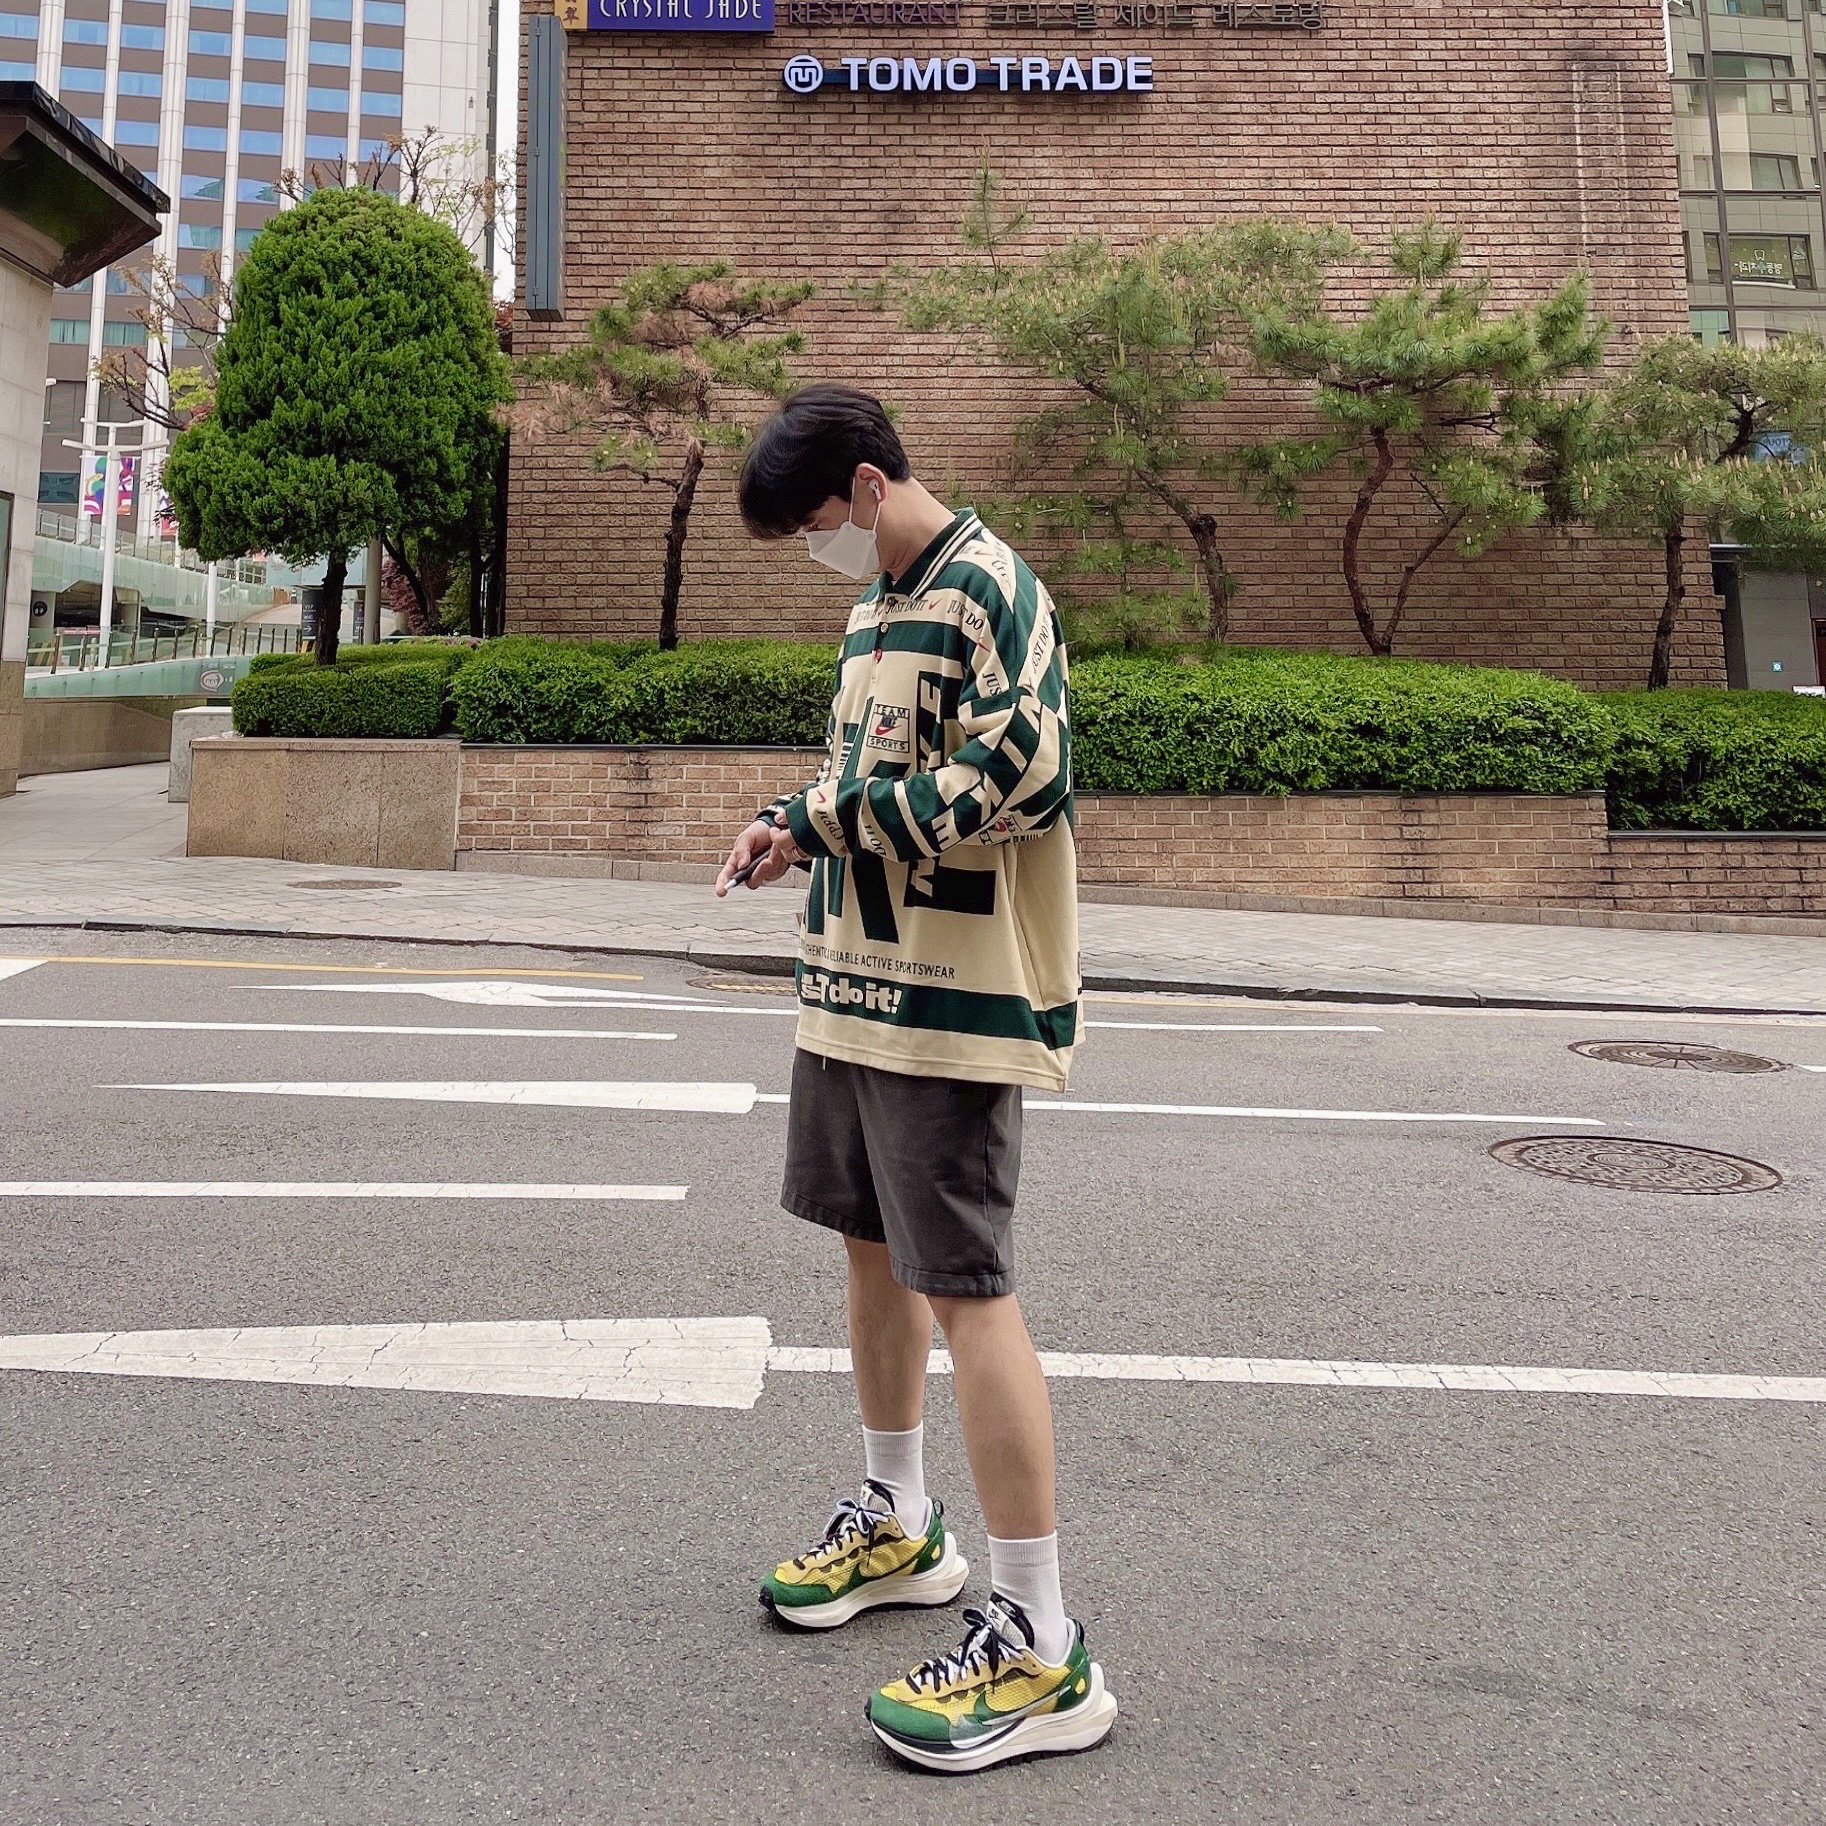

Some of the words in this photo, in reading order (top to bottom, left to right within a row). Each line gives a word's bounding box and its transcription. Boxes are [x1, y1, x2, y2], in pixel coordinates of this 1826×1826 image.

[600, 0, 692, 18] CRYSTAL
[705, 0, 762, 19] JADE
[788, 1, 960, 25] RESTAURANT
[1213, 1, 1325, 29] 레스토랑
[841, 57, 976, 91] TOMO
[990, 57, 1153, 91] TRADE
[947, 600, 968, 619] JUST
[965, 613, 984, 631] DO
[982, 672, 1001, 696] JUS
[876, 704, 908, 719] TEAM
[870, 737, 905, 751] SPORTS
[861, 955, 892, 971] ACTIVE
[895, 960, 955, 979] SPORTSWEAR
[829, 978, 863, 1004] do
[865, 982, 902, 1014] it!
